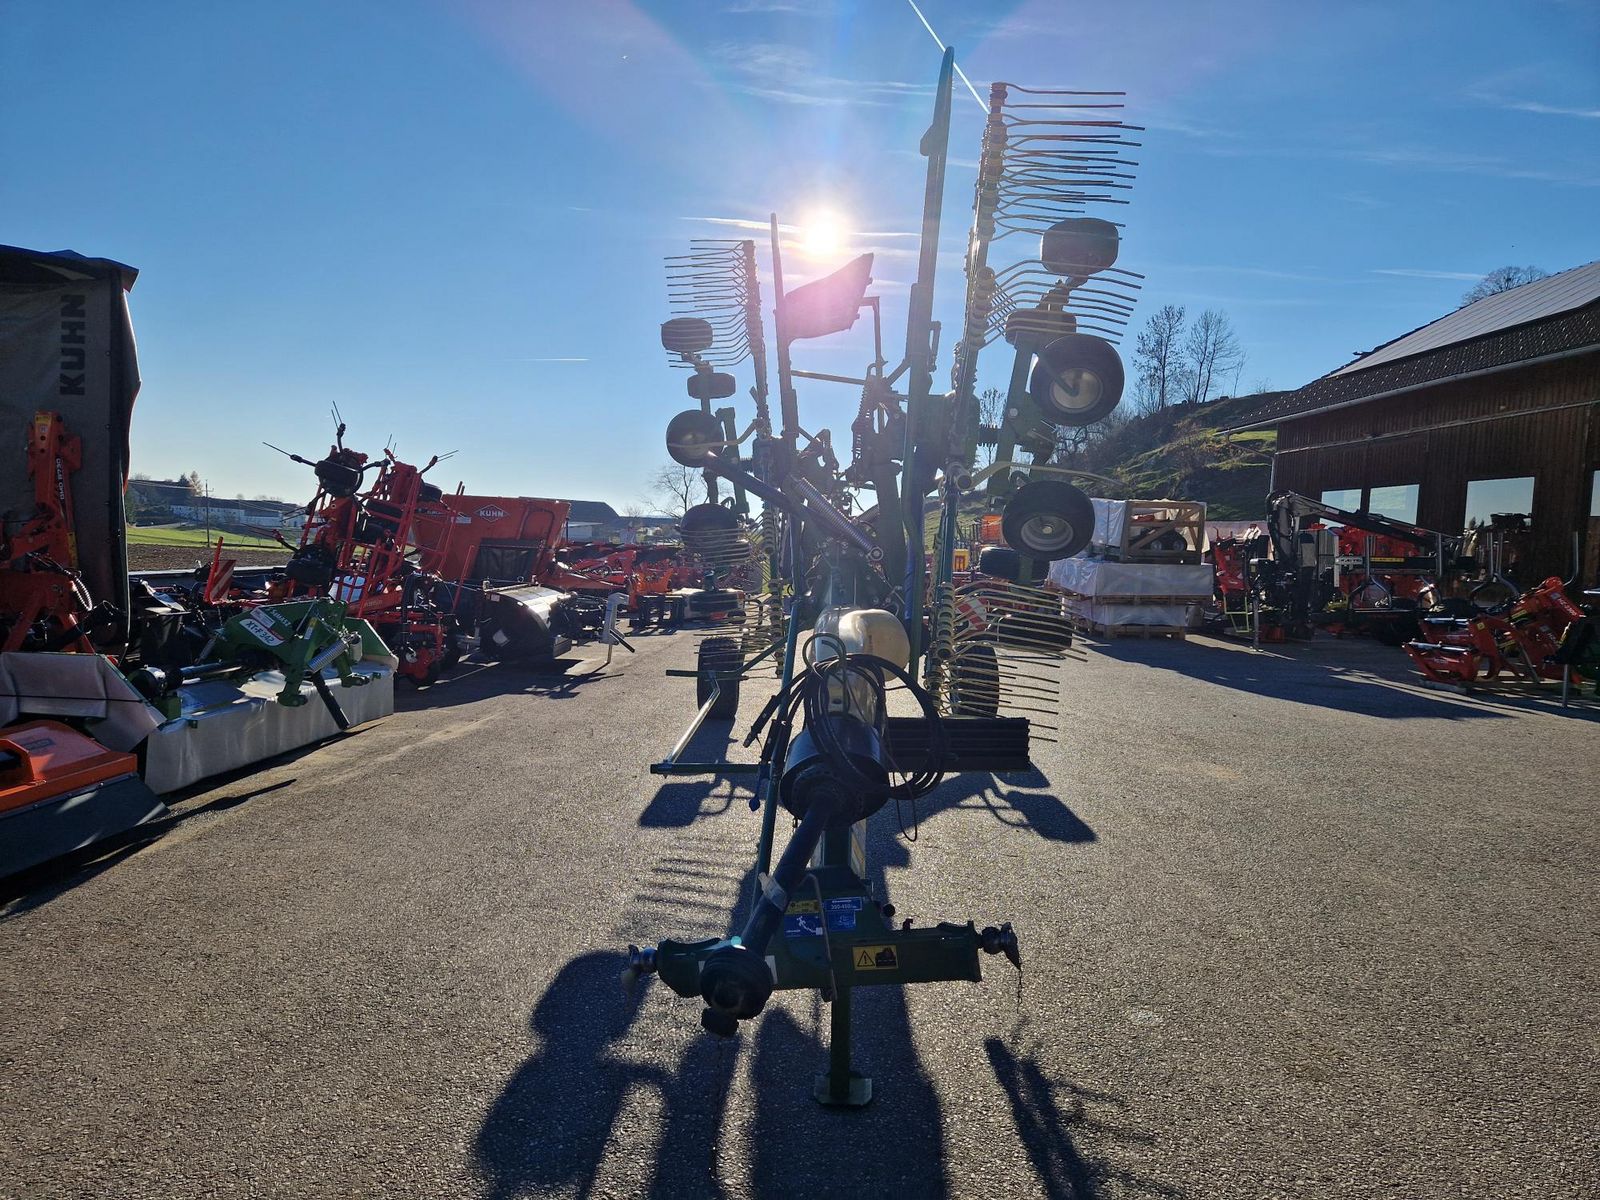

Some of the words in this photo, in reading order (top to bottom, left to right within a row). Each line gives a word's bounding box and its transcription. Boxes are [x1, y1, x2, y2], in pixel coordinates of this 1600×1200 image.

[59, 294, 86, 395] KUHN
[479, 510, 504, 518] KUHN
[259, 629, 276, 643] 342
